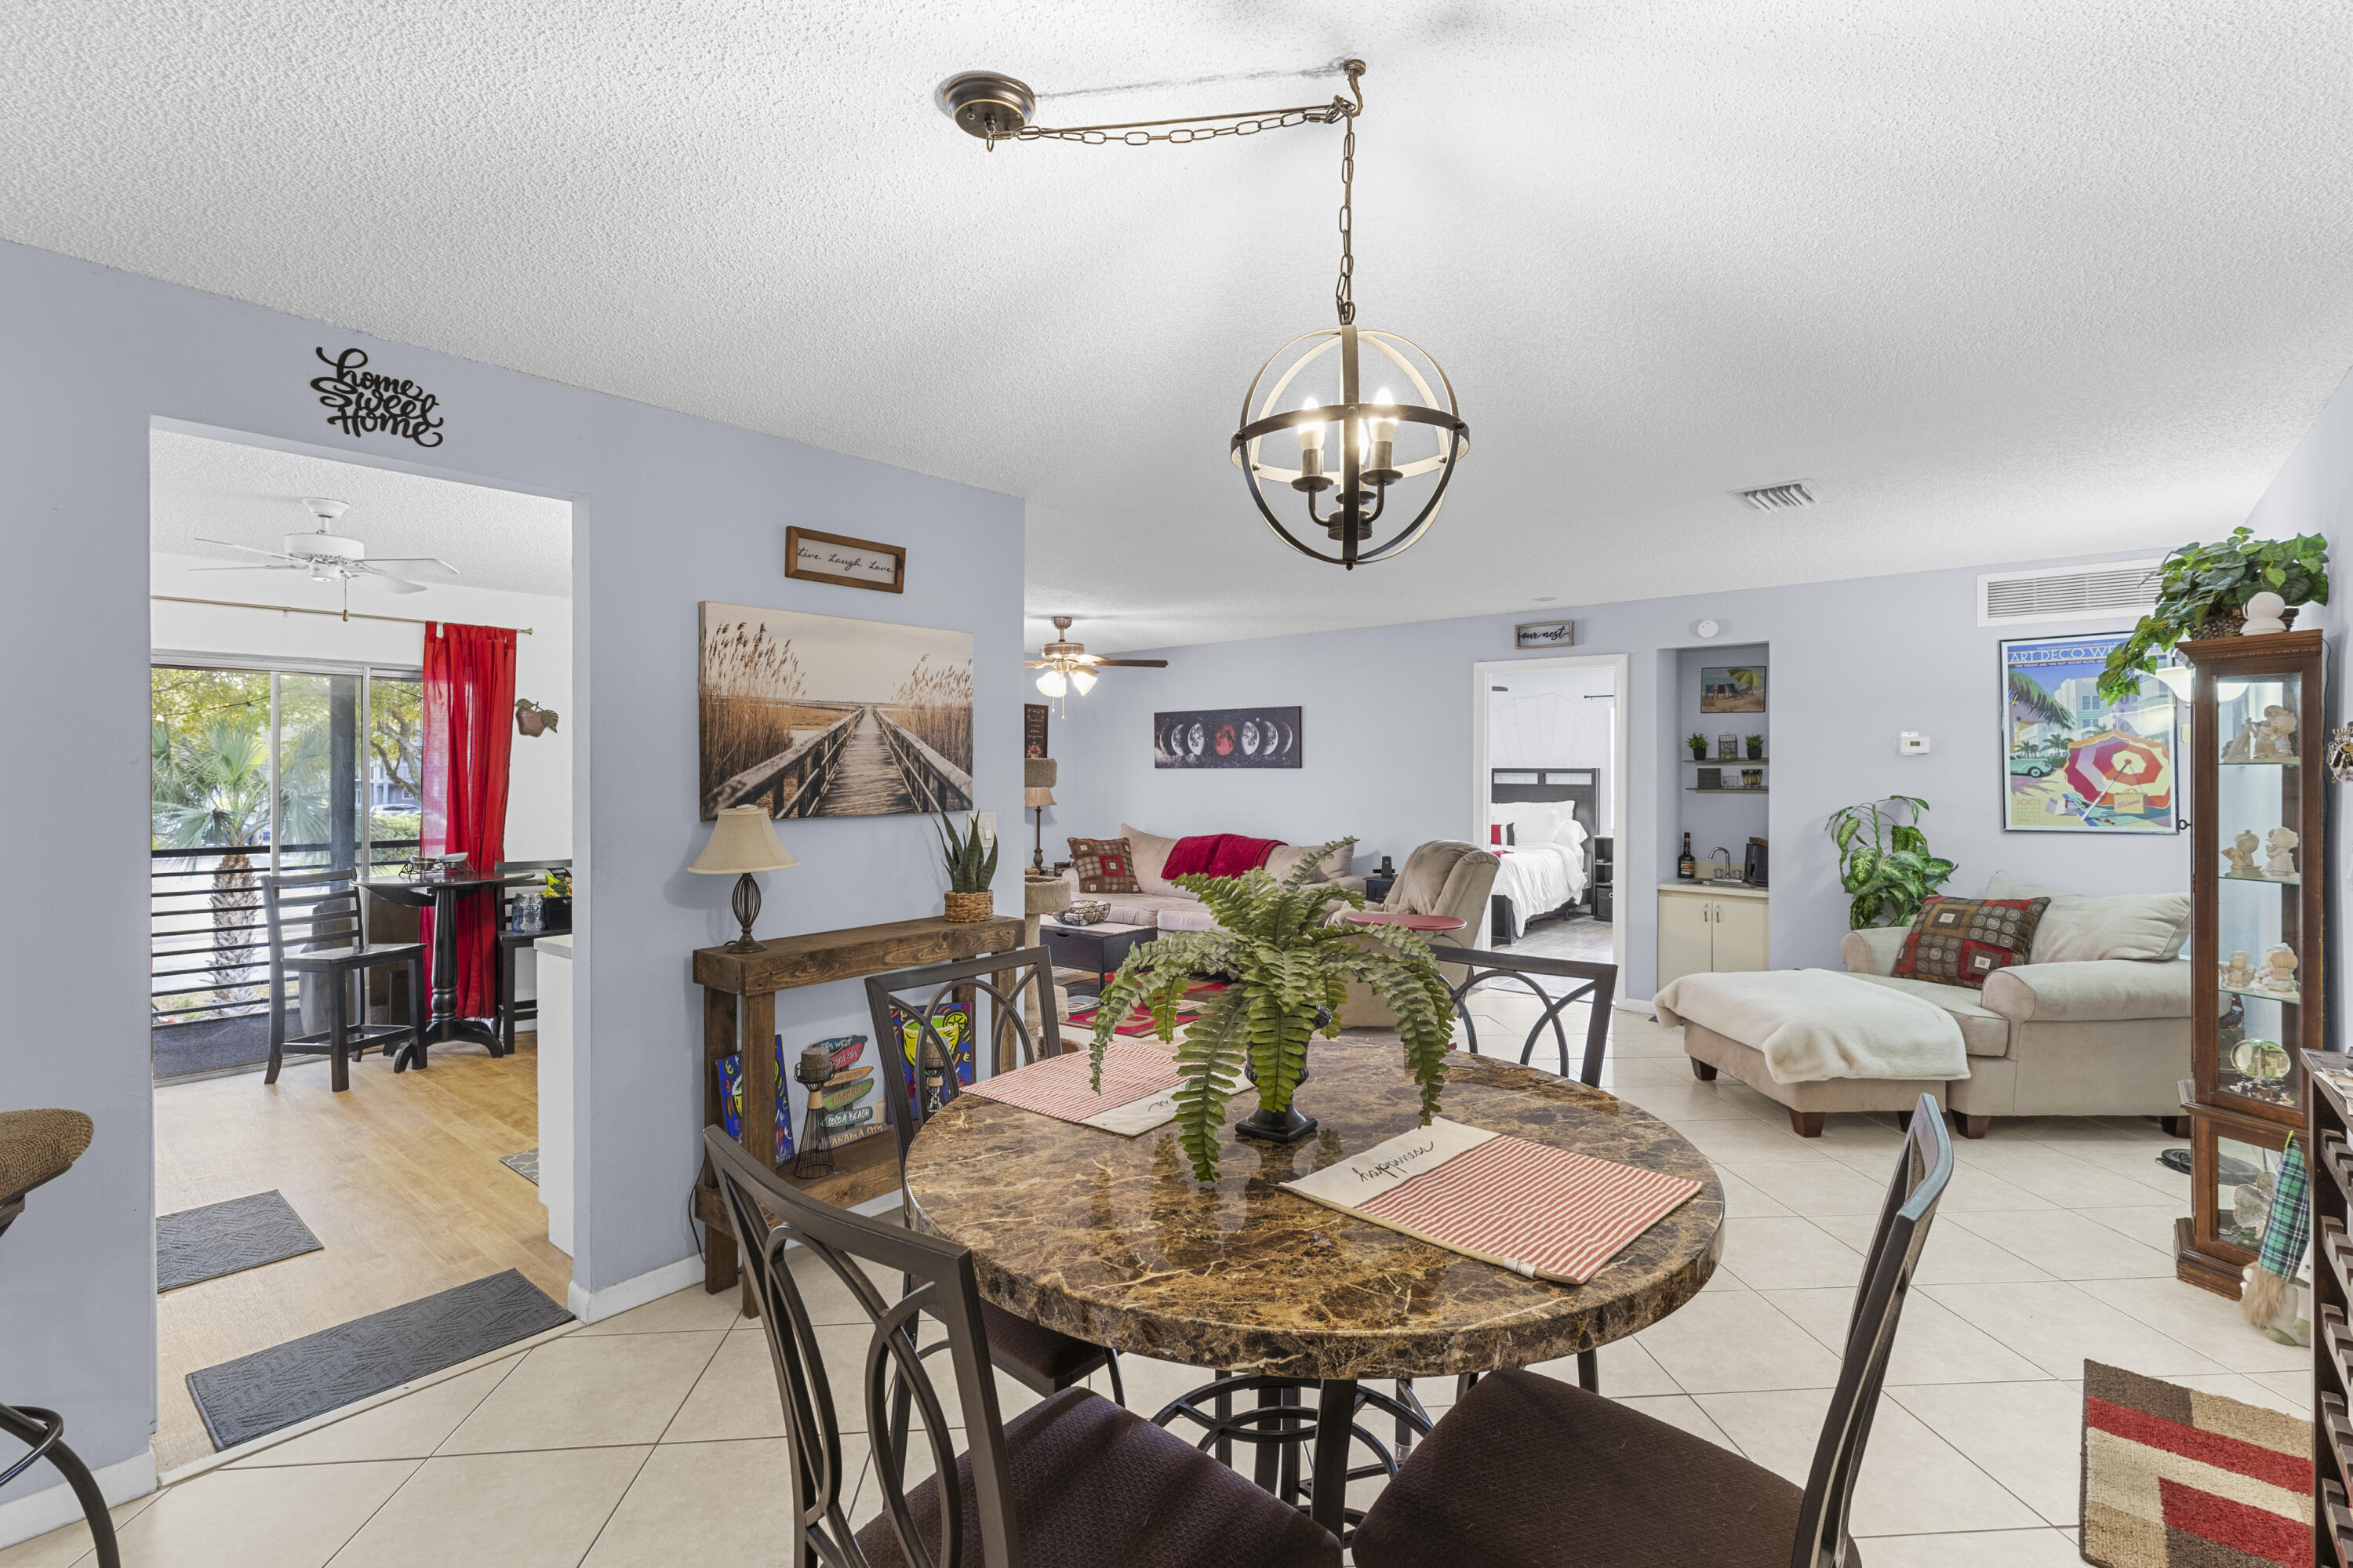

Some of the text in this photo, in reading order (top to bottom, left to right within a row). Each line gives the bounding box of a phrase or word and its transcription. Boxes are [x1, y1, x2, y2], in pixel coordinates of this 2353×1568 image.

[797, 548, 893, 573] Live Laugh Love
[1539, 626, 1569, 640] nest
[2011, 652, 2035, 662] ART
[2041, 649, 2085, 660] DECO
[828, 1108, 870, 1126] COCOA BEACH
[867, 1124, 883, 1134] CITY
[1351, 1141, 1434, 1182] happiness
